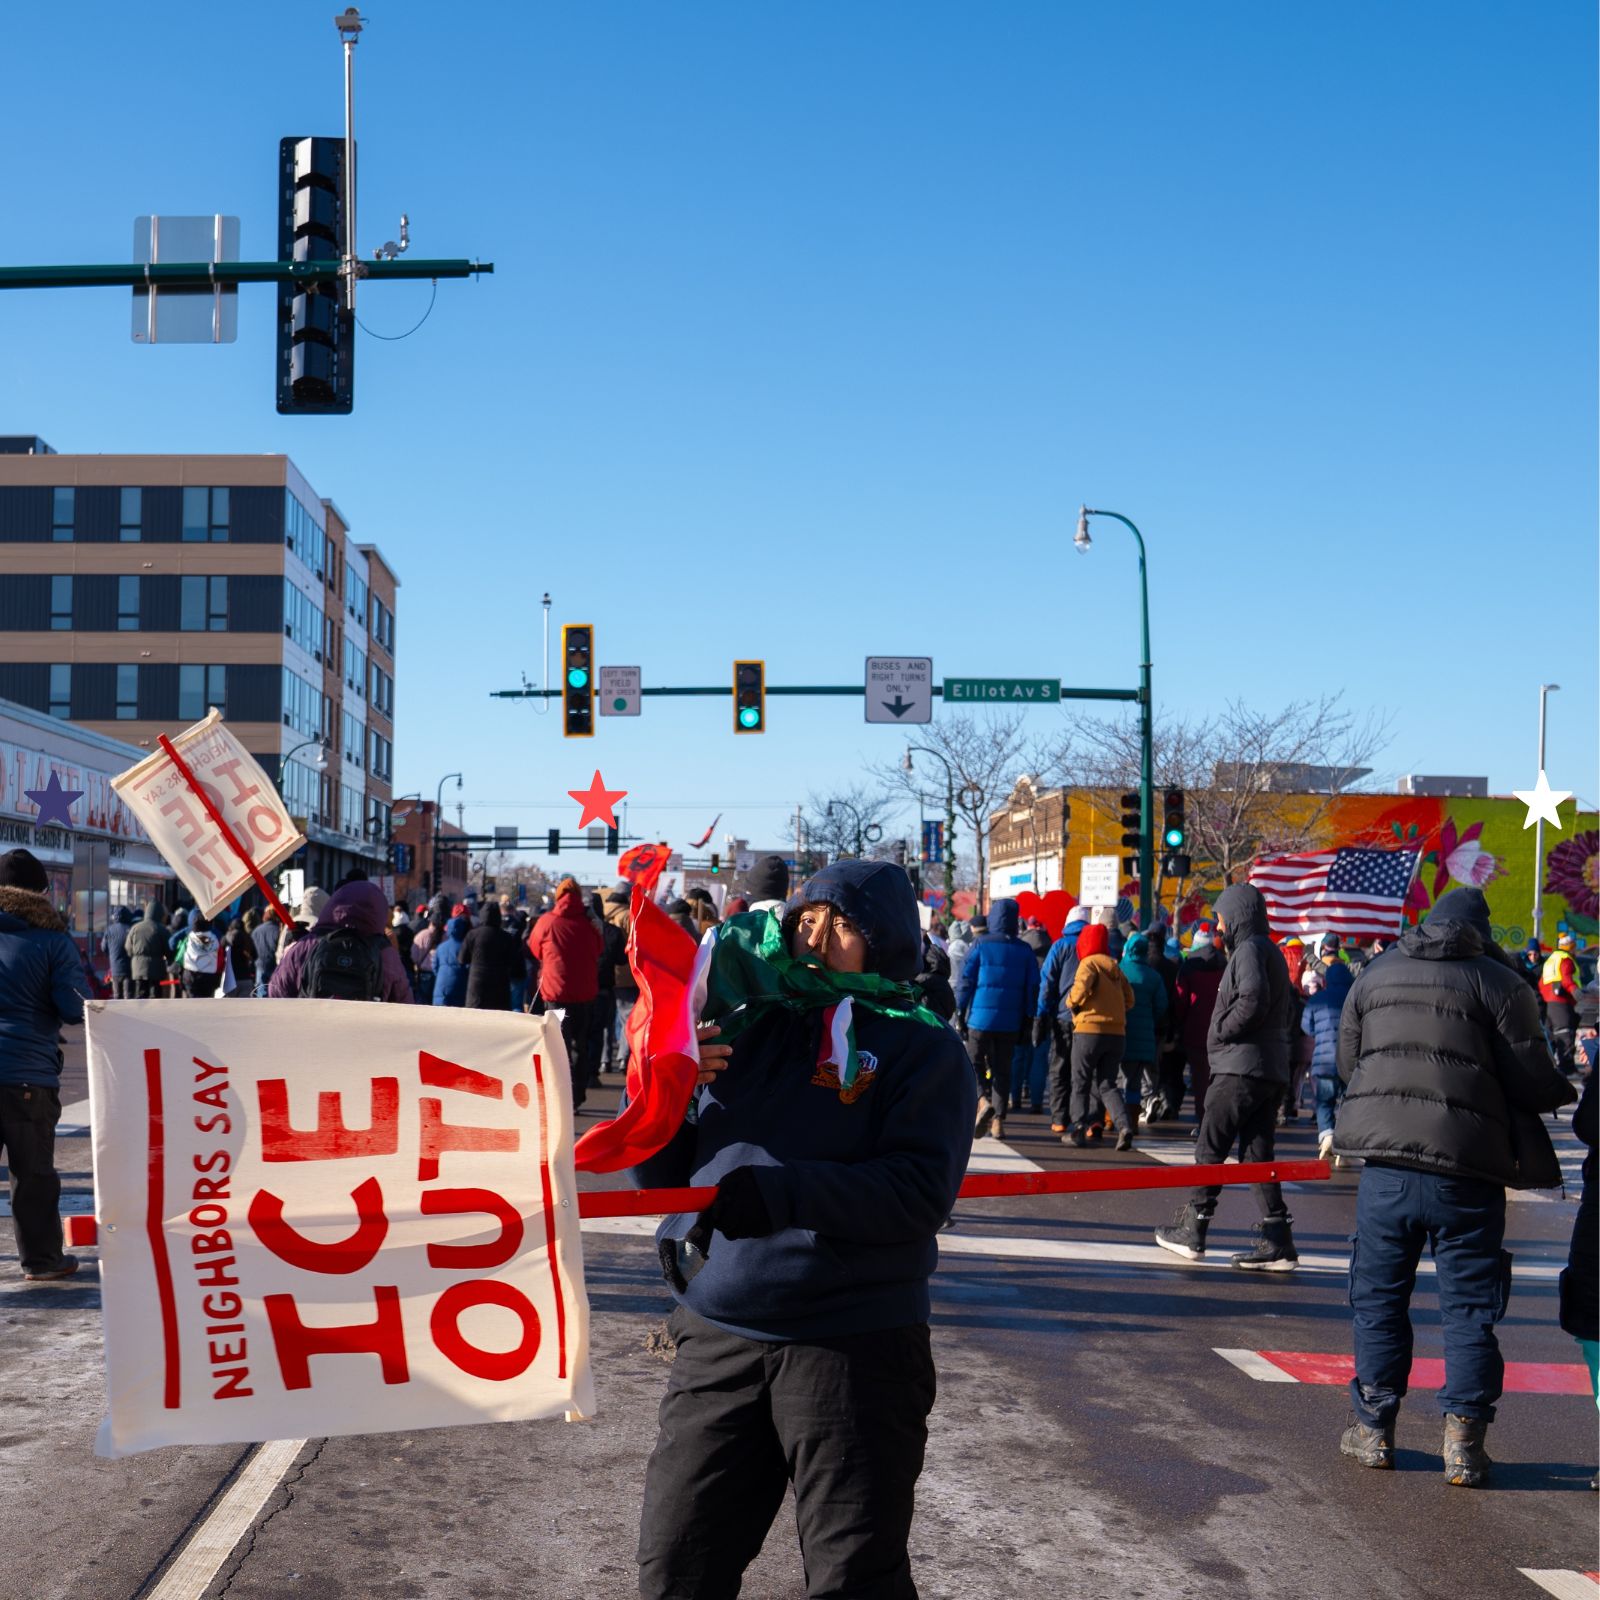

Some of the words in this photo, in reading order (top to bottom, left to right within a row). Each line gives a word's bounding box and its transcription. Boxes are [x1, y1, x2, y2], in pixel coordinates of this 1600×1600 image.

[871, 662, 900, 670] BUSES
[610, 679, 631, 687] YIELD
[871, 673, 894, 682] RIGHT
[901, 673, 926, 682] TURNS
[886, 685, 910, 693] ONLY
[952, 684, 1006, 697] Elliot
[1012, 685, 1034, 697] Av
[1041, 685, 1051, 698] S
[193, 1057, 231, 1135] SAY
[418, 1050, 542, 1382] OUT!
[248, 1076, 410, 1391] ICE
[188, 1149, 253, 1400] NEIGHBORS
